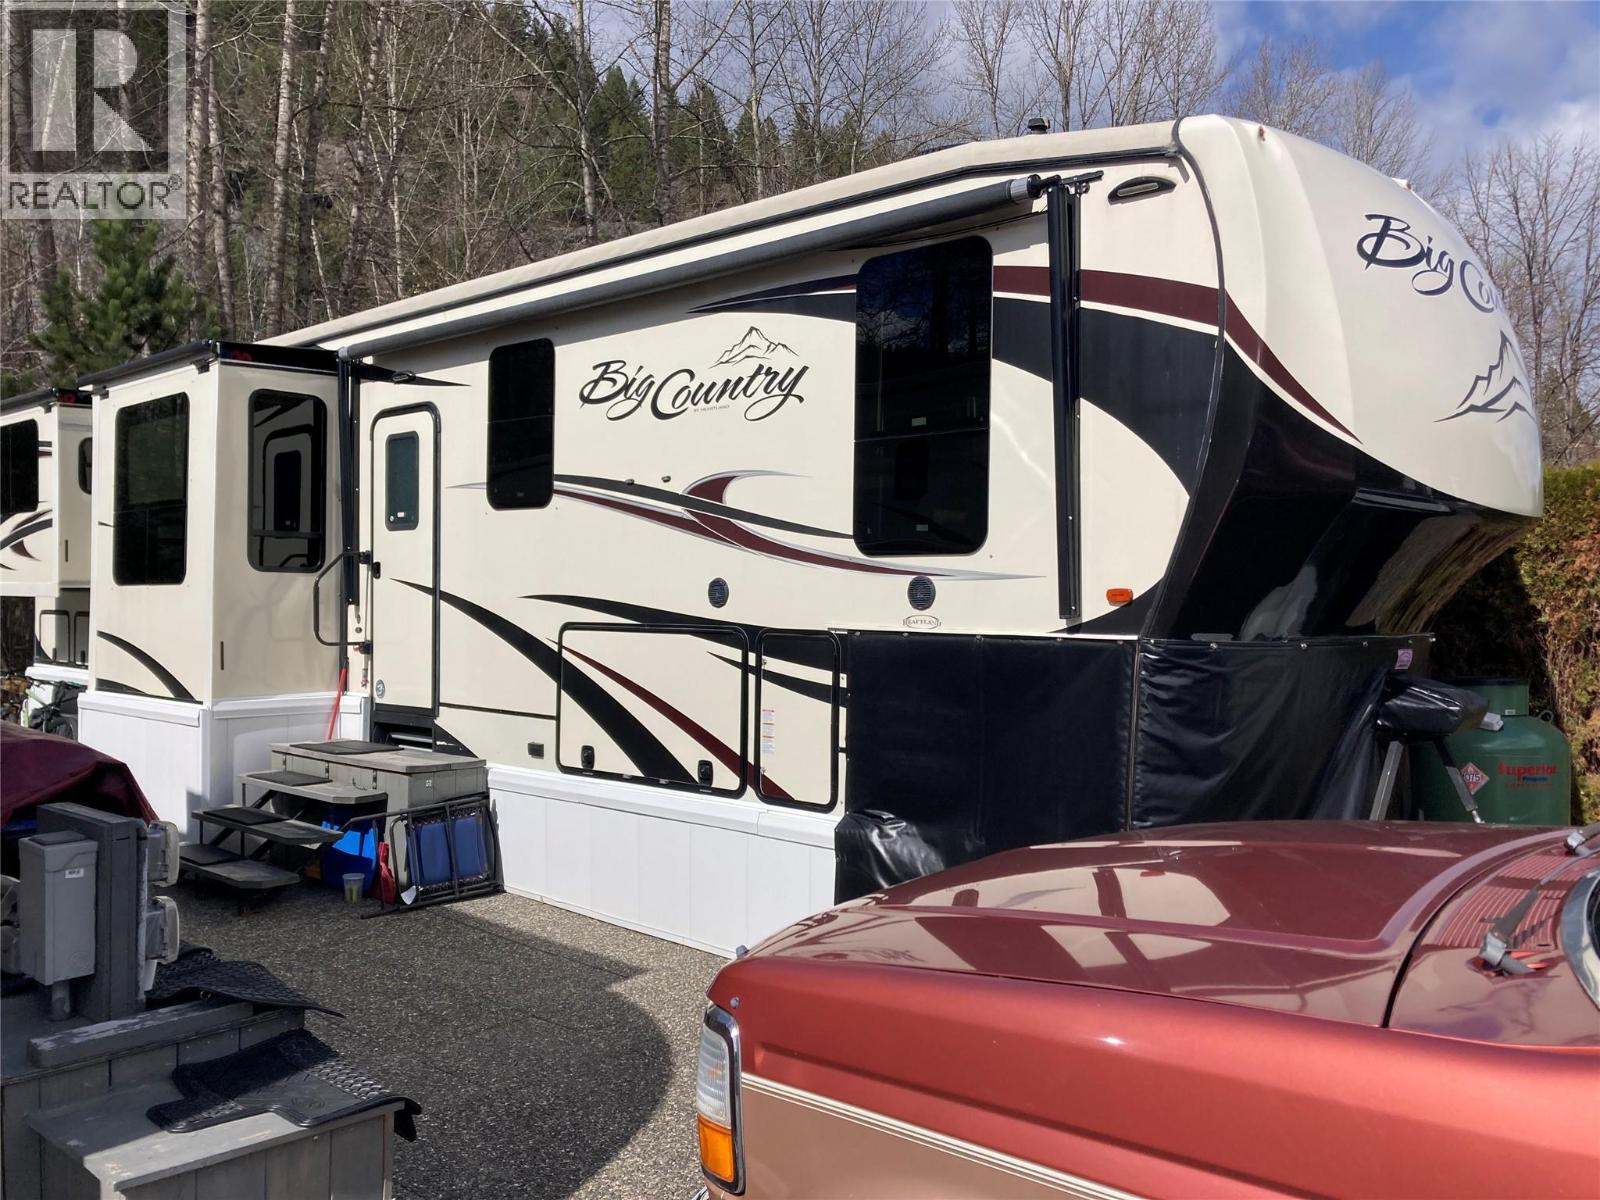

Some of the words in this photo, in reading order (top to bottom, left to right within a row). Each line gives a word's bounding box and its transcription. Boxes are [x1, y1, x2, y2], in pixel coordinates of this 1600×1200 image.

[1357, 214, 1454, 296] Big
[579, 360, 654, 421] Big
[651, 364, 809, 421] Country
